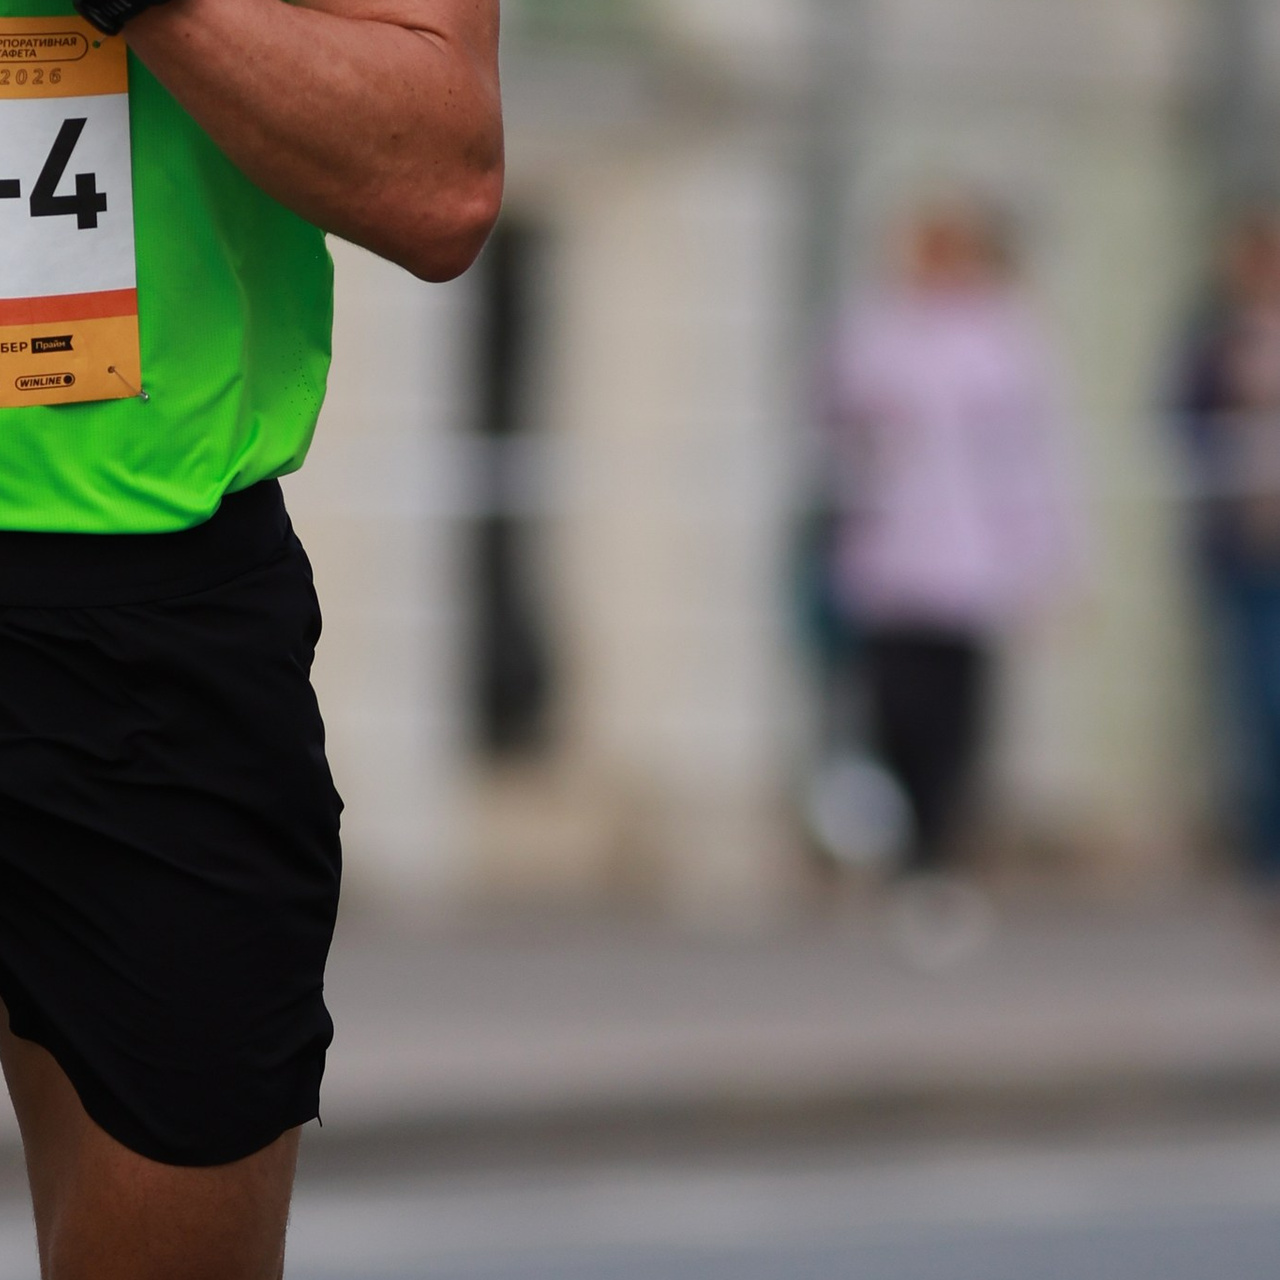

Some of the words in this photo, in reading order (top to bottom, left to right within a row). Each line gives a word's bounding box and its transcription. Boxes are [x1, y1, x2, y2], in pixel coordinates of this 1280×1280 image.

[0, 68, 62, 85] 2026
[35, 340, 66, 350] Прайм
[20, 376, 62, 387] WINLINE
